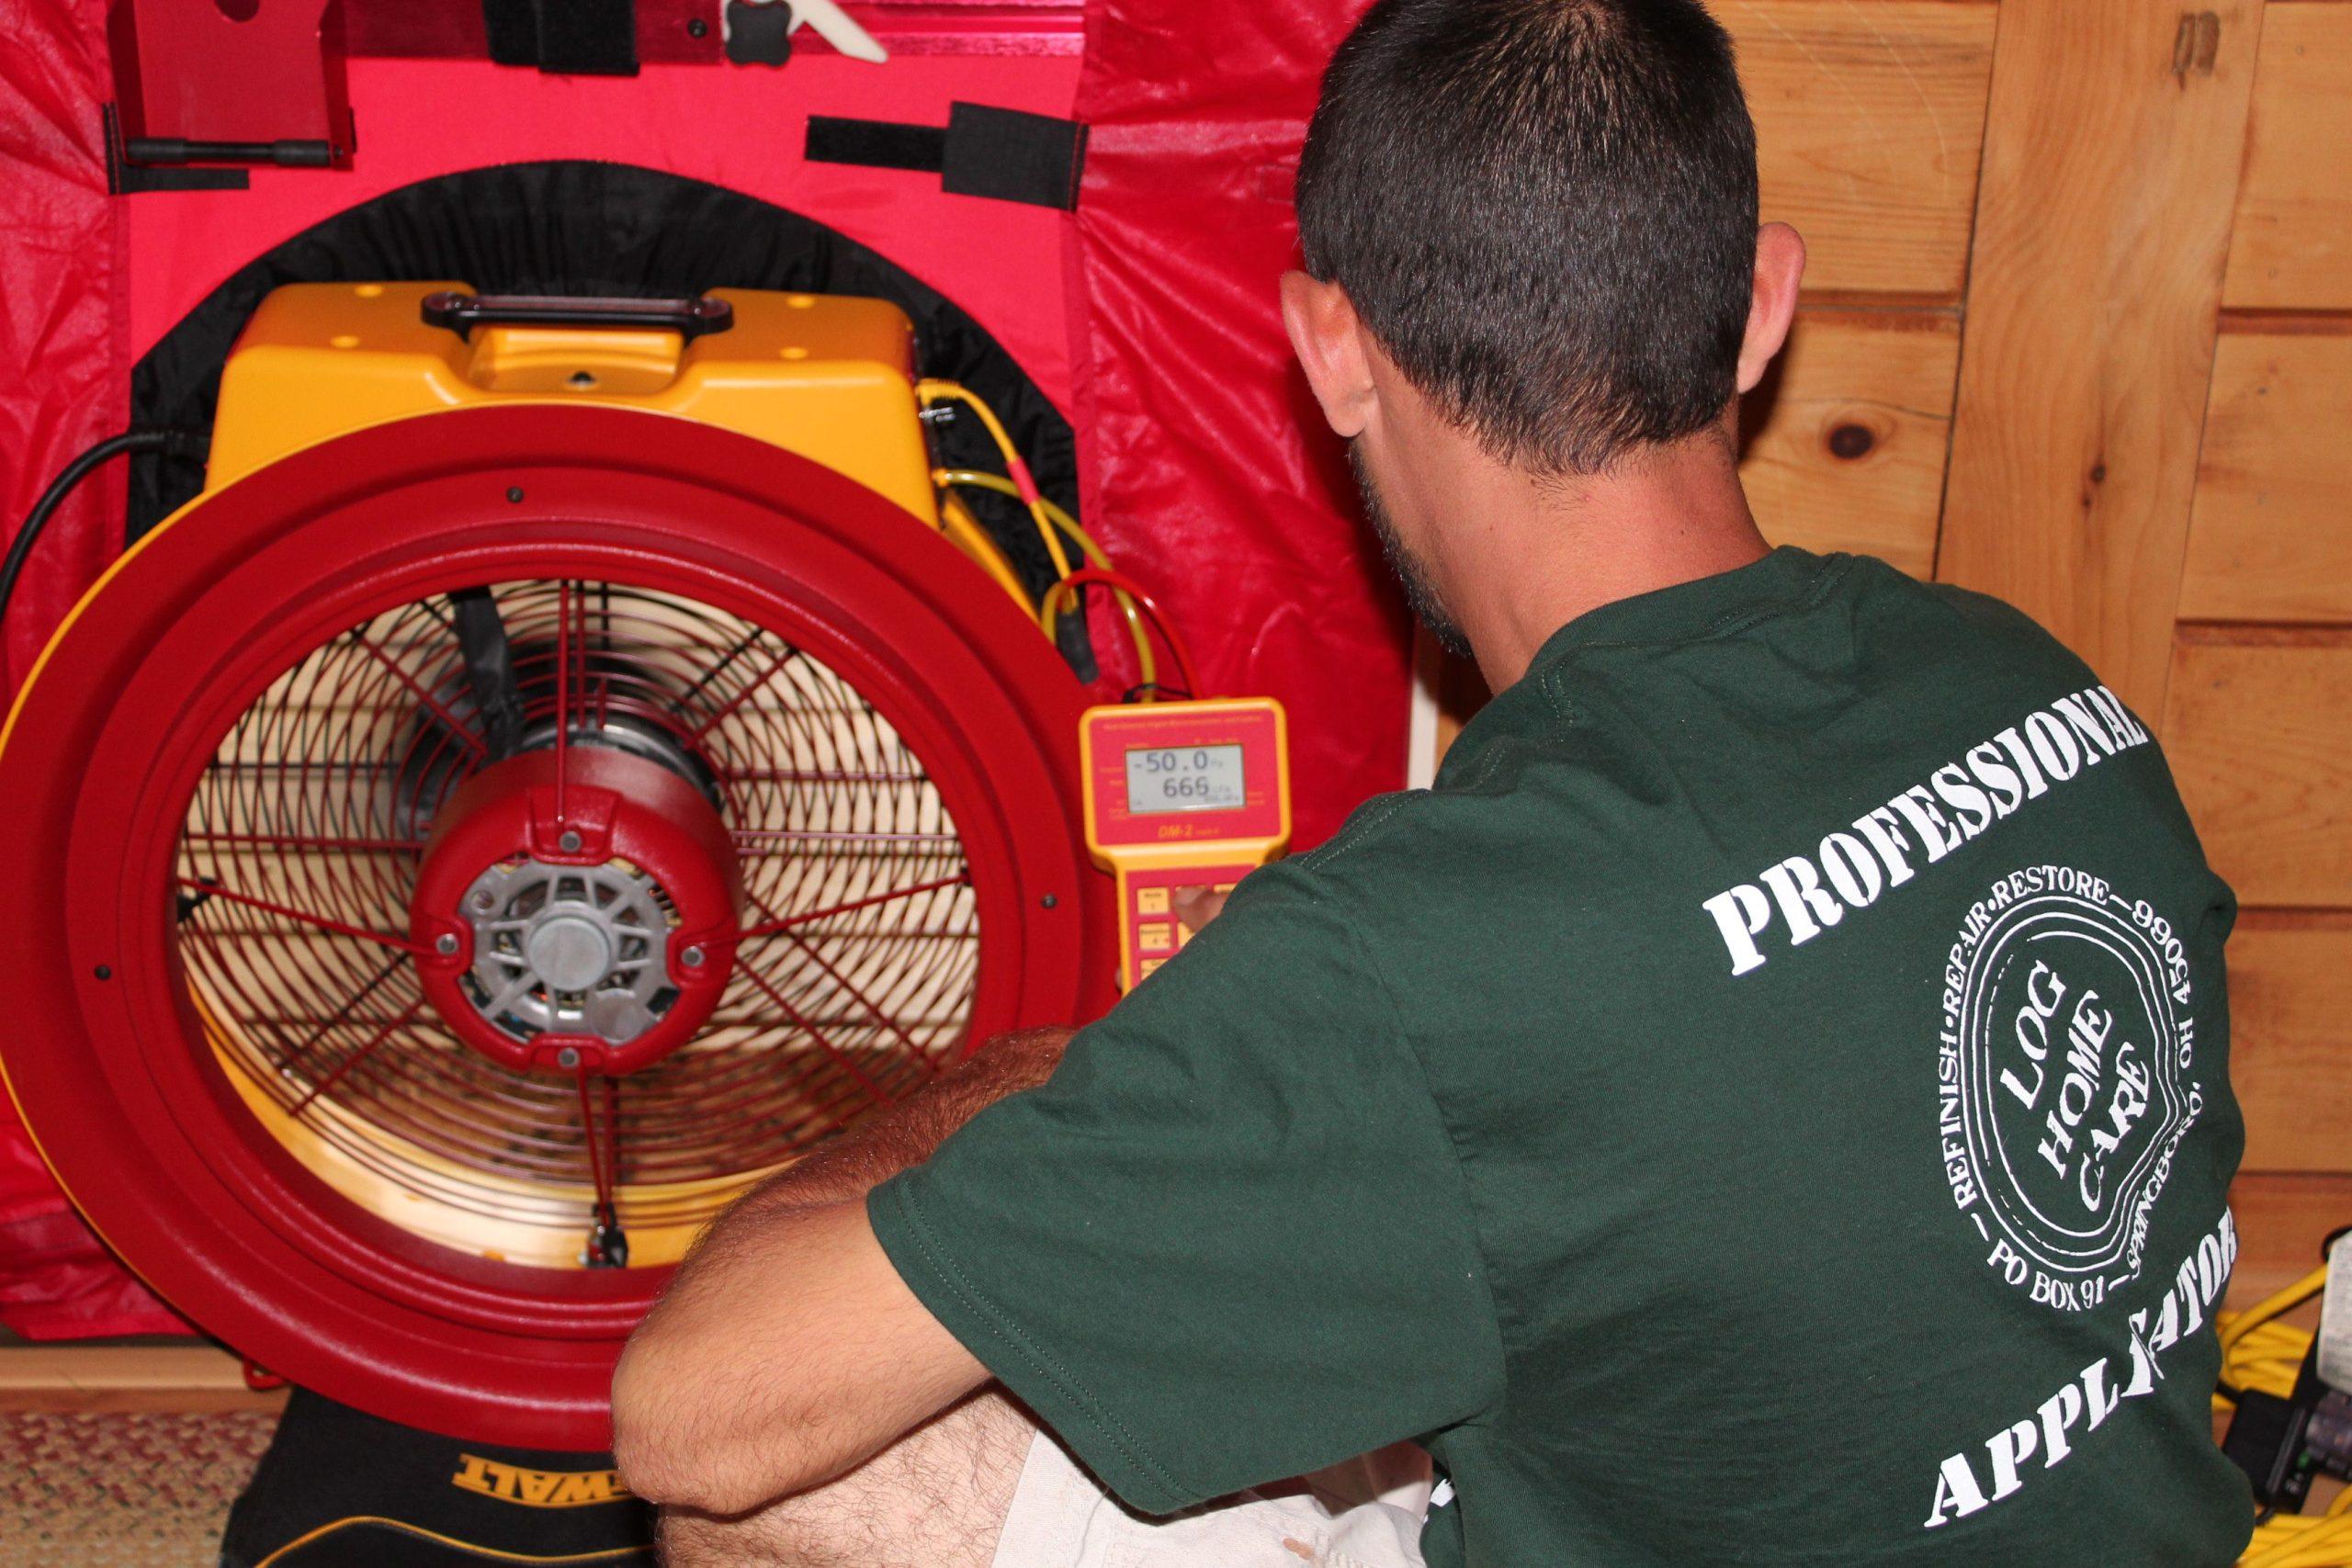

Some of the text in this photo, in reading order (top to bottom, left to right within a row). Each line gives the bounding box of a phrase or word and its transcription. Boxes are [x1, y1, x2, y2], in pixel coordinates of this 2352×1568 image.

[1163, 776, 1209, 797] 666
[1702, 685, 2149, 976] PROFESSIONAL
[2132, 899, 2192, 1005] 45066
[1999, 960, 2067, 1110] LOG
[2177, 1017, 2194, 1069] OH
[2038, 990, 2113, 1180] HOME
[2080, 1042, 2150, 1212] CARE
[1987, 1237, 2028, 1285] PO
[2029, 1270, 2082, 1312] BOX
[2080, 1275, 2105, 1311] 91
